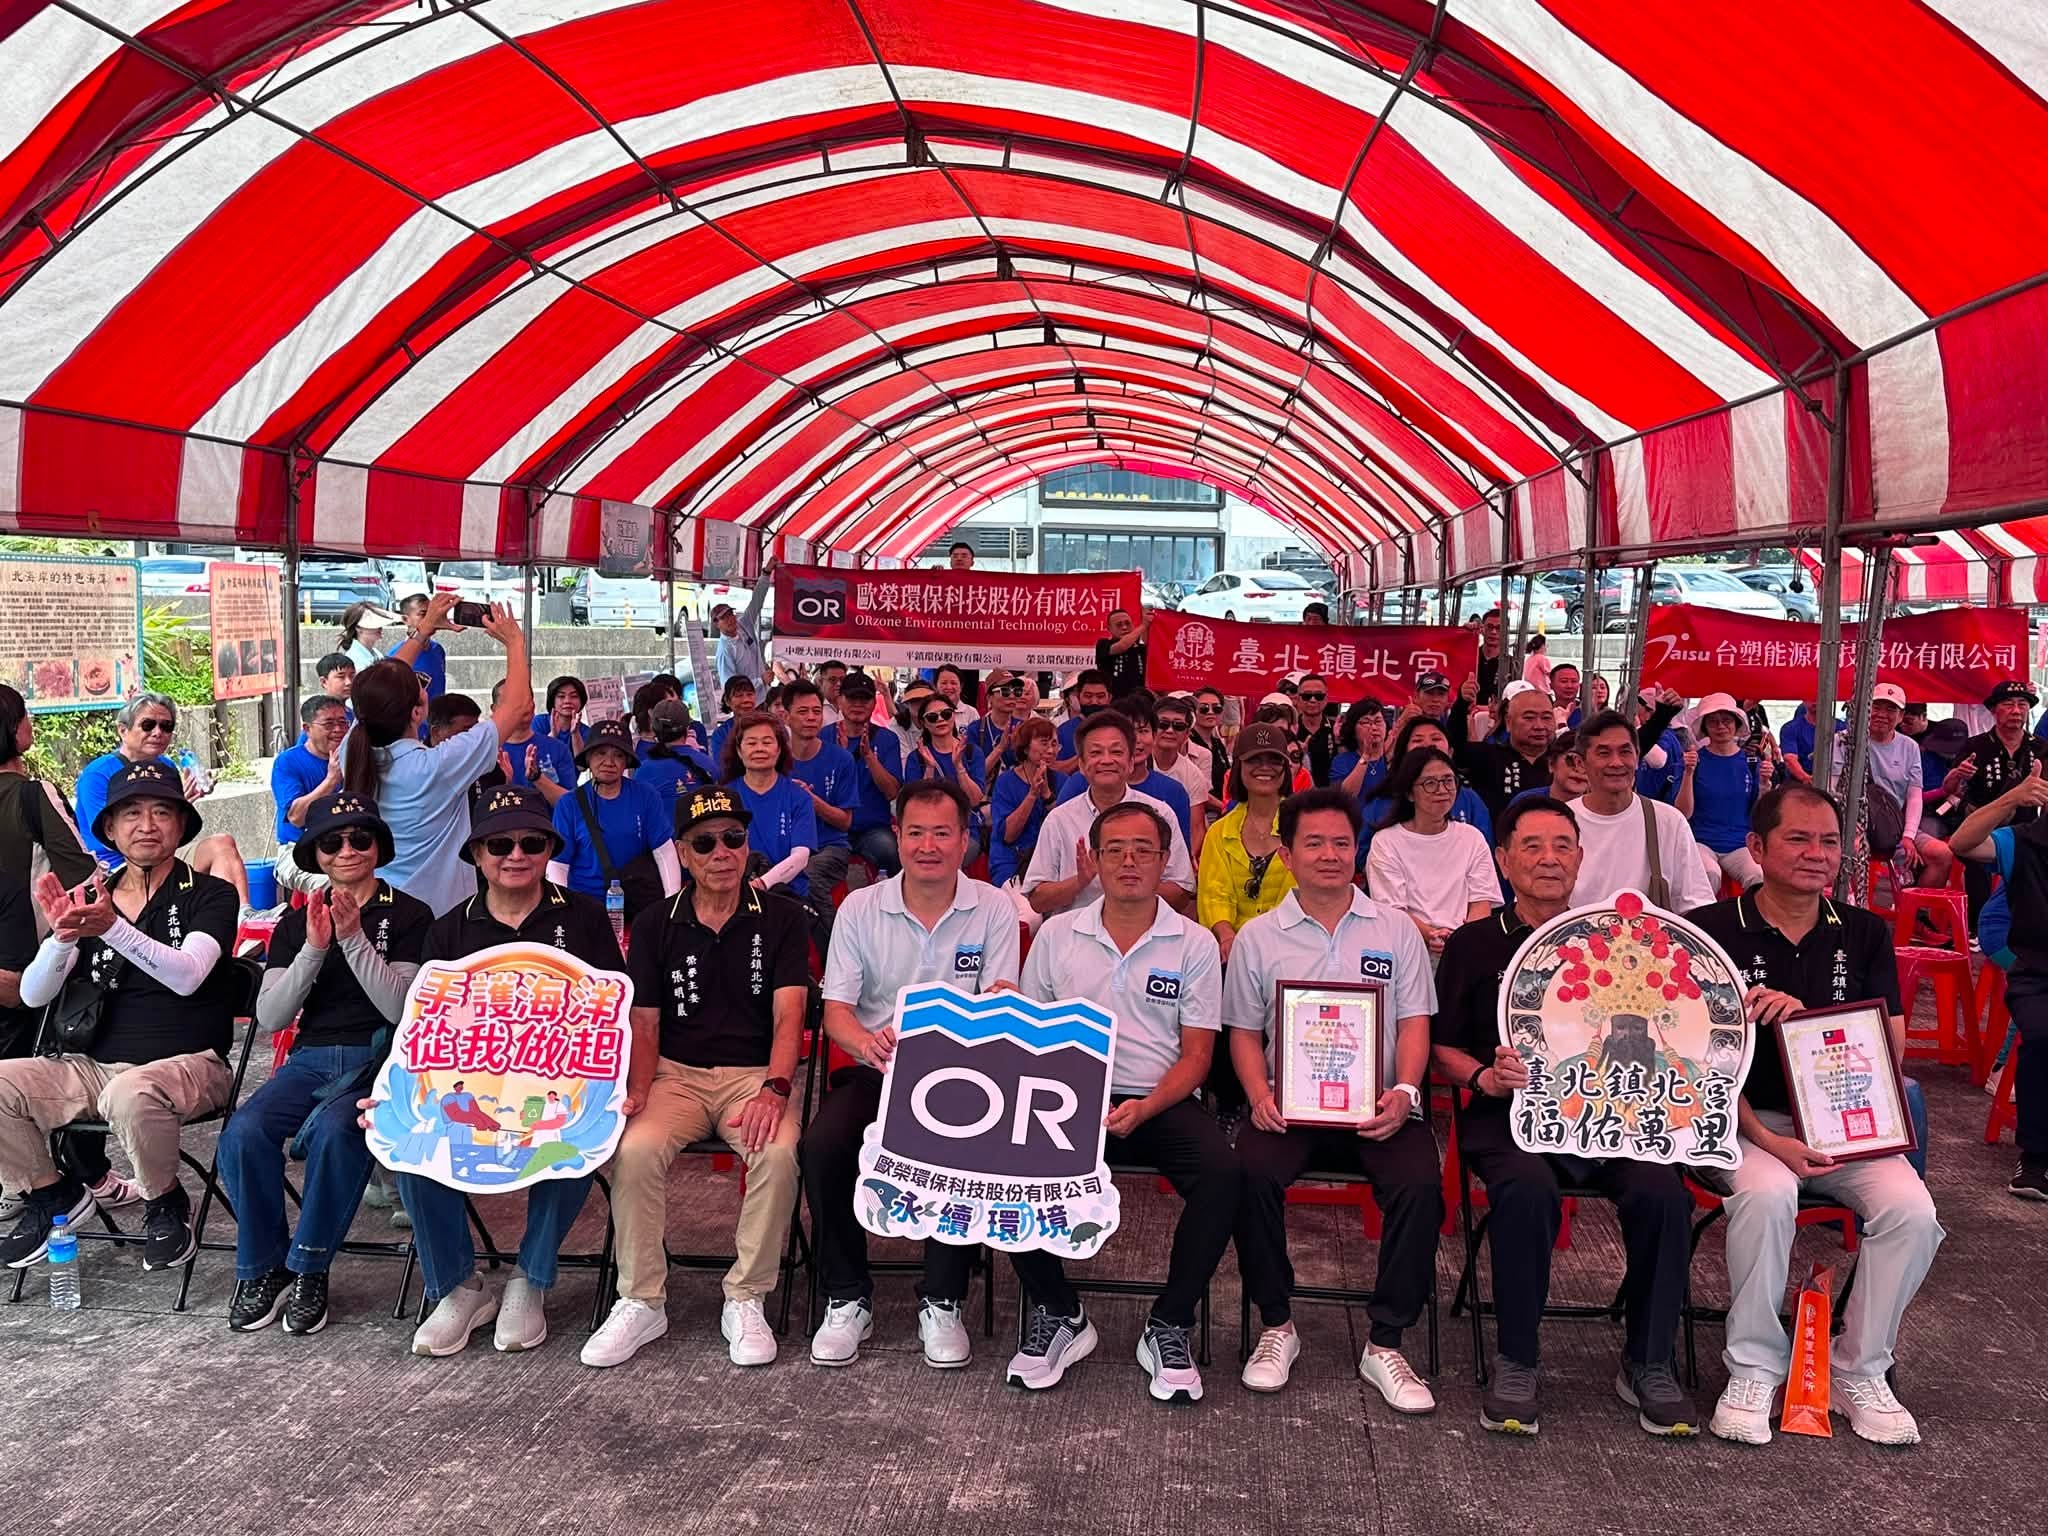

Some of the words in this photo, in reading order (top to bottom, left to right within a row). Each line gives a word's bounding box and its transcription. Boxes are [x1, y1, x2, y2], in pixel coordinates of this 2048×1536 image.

[797, 597, 841, 618] OR
[856, 582, 1121, 617] 歐榮環保科技股份有限公司
[855, 615, 901, 627] ORzone
[904, 617, 995, 631] Environmental
[999, 619, 1068, 634] Technology
[1228, 638, 1448, 684] 臺北鎮北宮
[750, 933, 763, 994] 臺北鎮北宮
[958, 956, 980, 968] OR
[1364, 960, 1390, 976] OR
[1832, 950, 1848, 1005] 臺北鎮北
[1150, 980, 1177, 995] OR
[402, 1020, 622, 1080] 從我做起
[1524, 1057, 1735, 1111] 臺北鎮北宮
[911, 1067, 1078, 1151] OR
[1520, 1100, 1735, 1161] 福佑萬里
[873, 1154, 1102, 1203] 歐榮環保科技股份有限公司
[890, 1191, 1072, 1243] 永續環境
